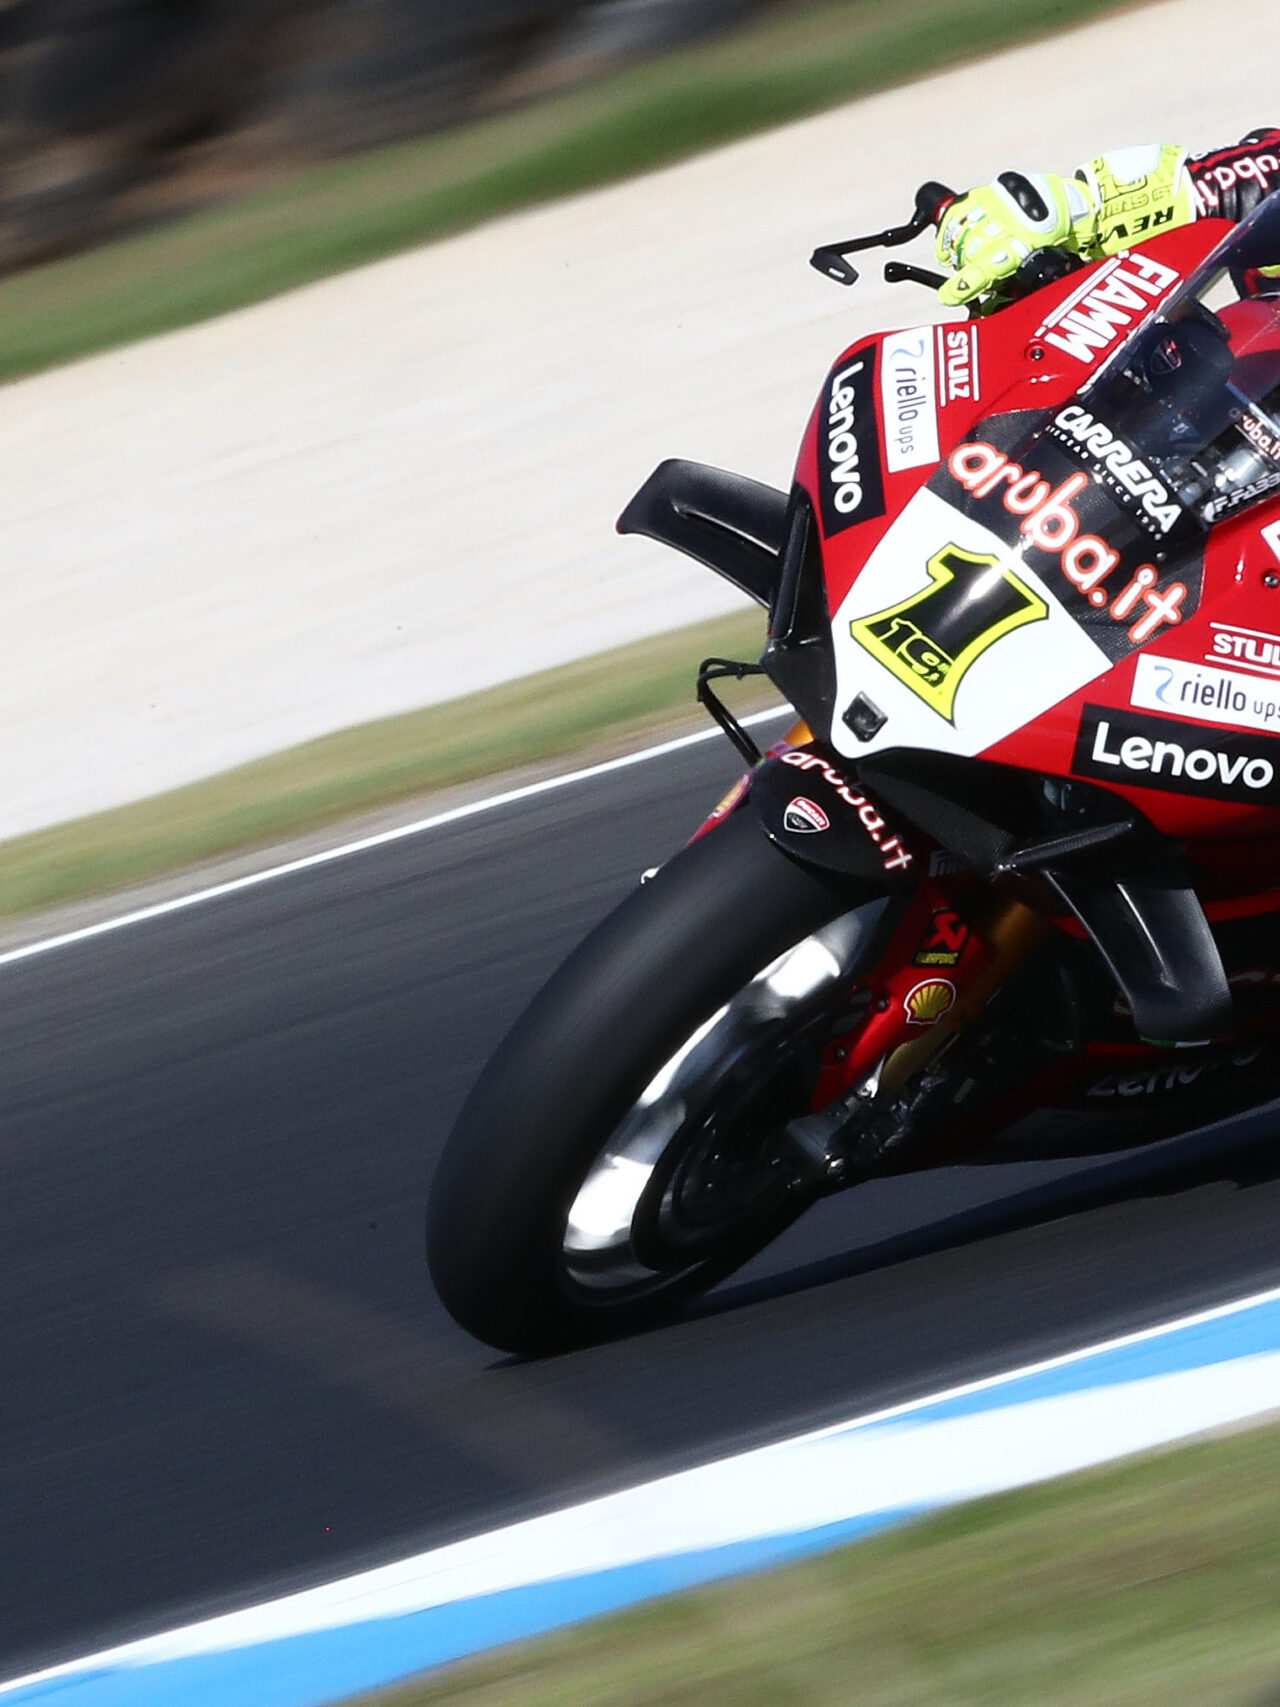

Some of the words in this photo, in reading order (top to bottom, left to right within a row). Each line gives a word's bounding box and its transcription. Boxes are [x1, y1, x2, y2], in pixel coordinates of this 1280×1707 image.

[1044, 250, 1180, 364] FIAMM
[894, 367, 926, 424] riello
[946, 330, 971, 401] STULZ
[827, 361, 864, 514] Lenovo
[894, 425, 915, 455] ups
[1055, 405, 1181, 534] CARRERA
[949, 441, 1187, 643] aruba.it
[1180, 673, 1247, 712] riello
[1091, 721, 1274, 789] Lenovo
